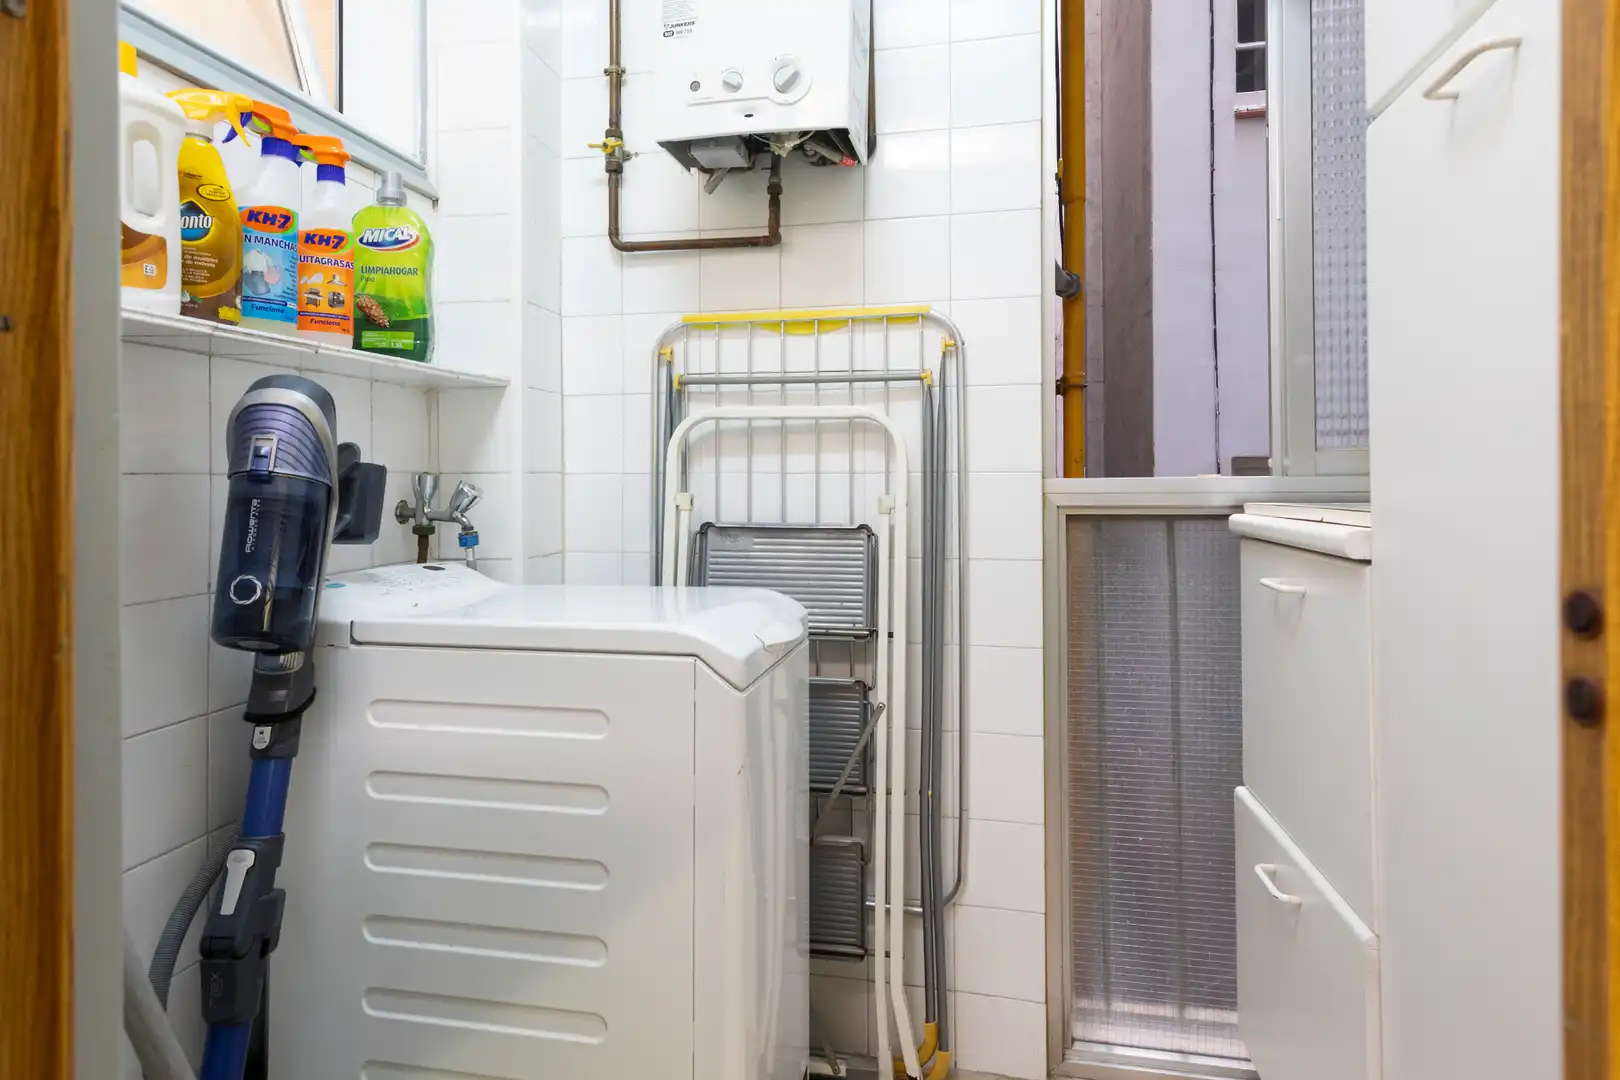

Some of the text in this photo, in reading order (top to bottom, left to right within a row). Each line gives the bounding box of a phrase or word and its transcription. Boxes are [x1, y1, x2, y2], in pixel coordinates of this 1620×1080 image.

[181, 213, 212, 229] onto
[362, 225, 412, 243] MICAL
[299, 254, 355, 270] UITAGRASAS
[360, 265, 419, 276] LIMPIAHOGAR
